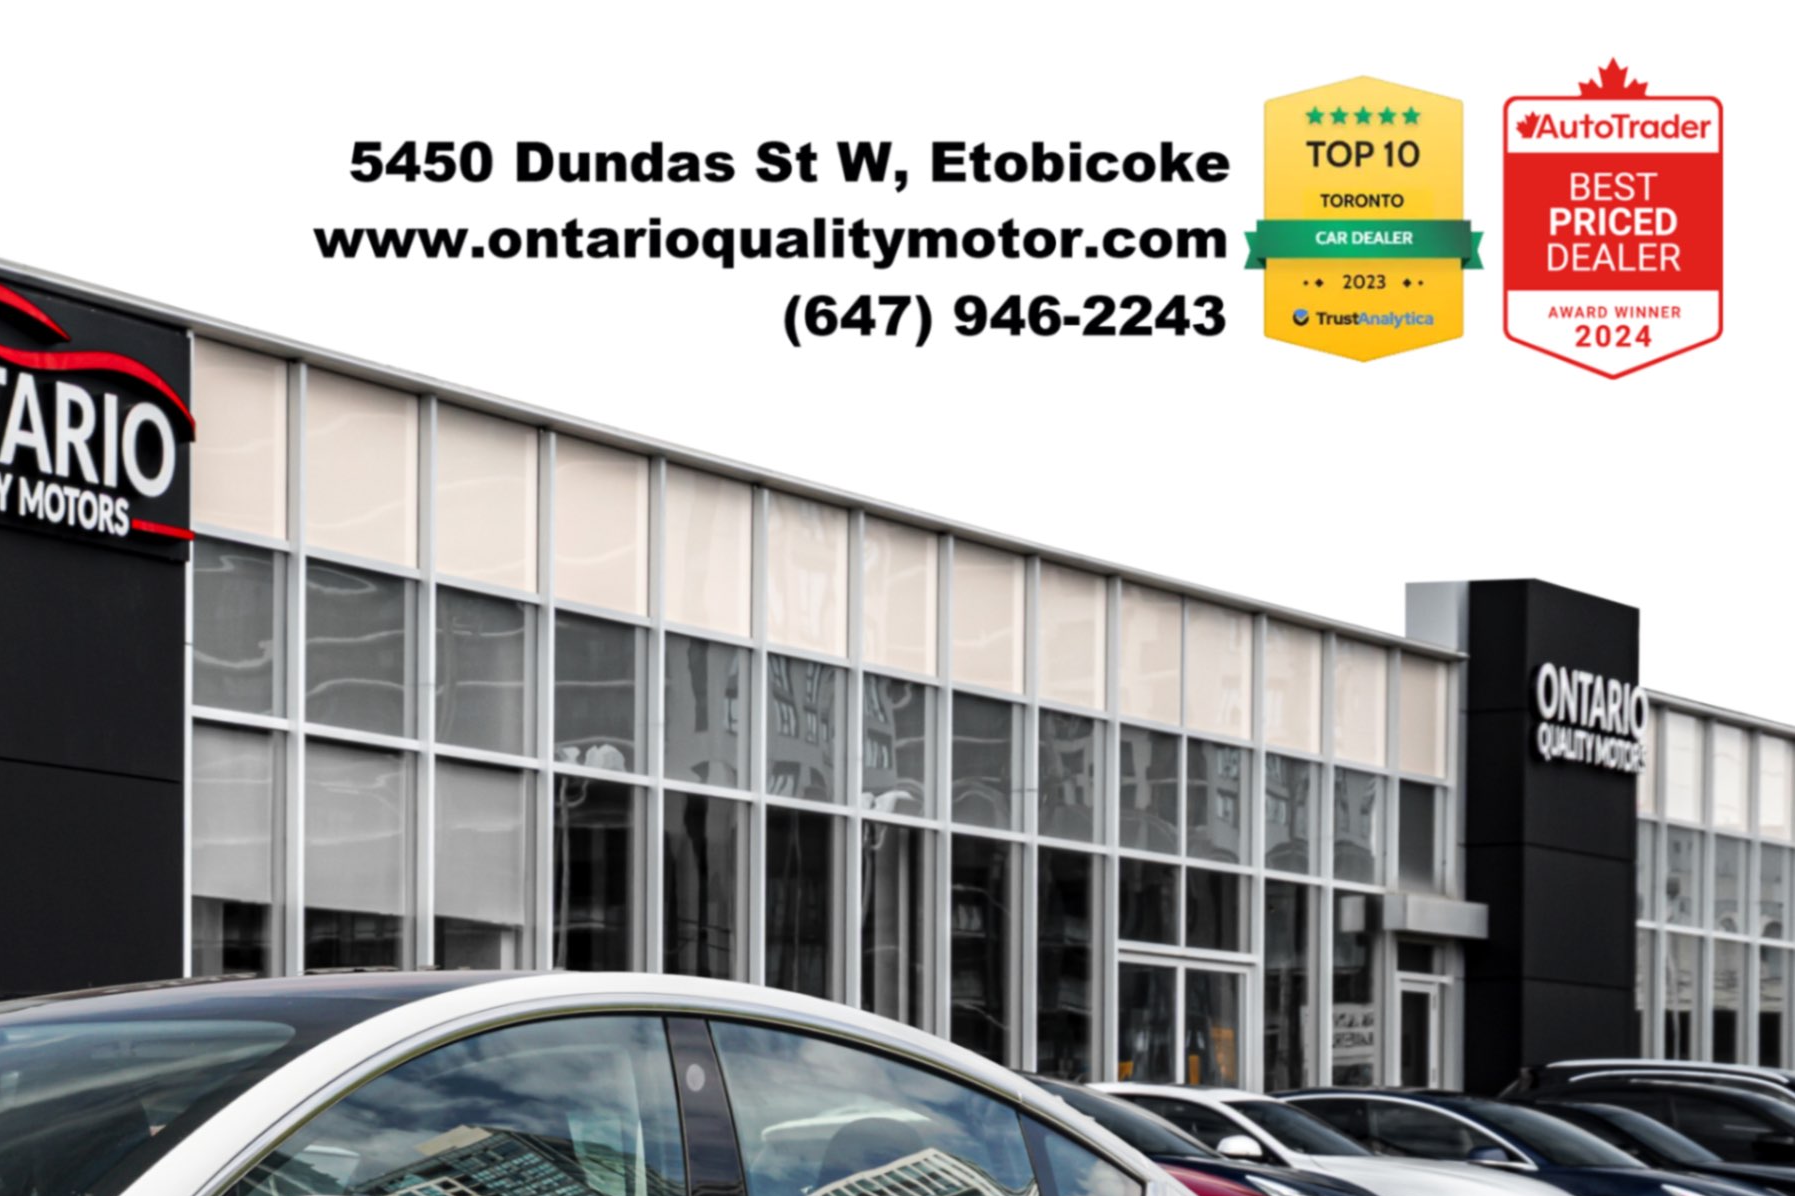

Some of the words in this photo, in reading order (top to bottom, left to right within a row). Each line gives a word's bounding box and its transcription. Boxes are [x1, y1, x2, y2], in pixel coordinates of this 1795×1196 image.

[19, 476, 130, 537] MOTORS
[1537, 662, 1649, 741] ONTARIO
[1537, 721, 1594, 763] QUALITY
[1594, 734, 1646, 774] MOTORS
